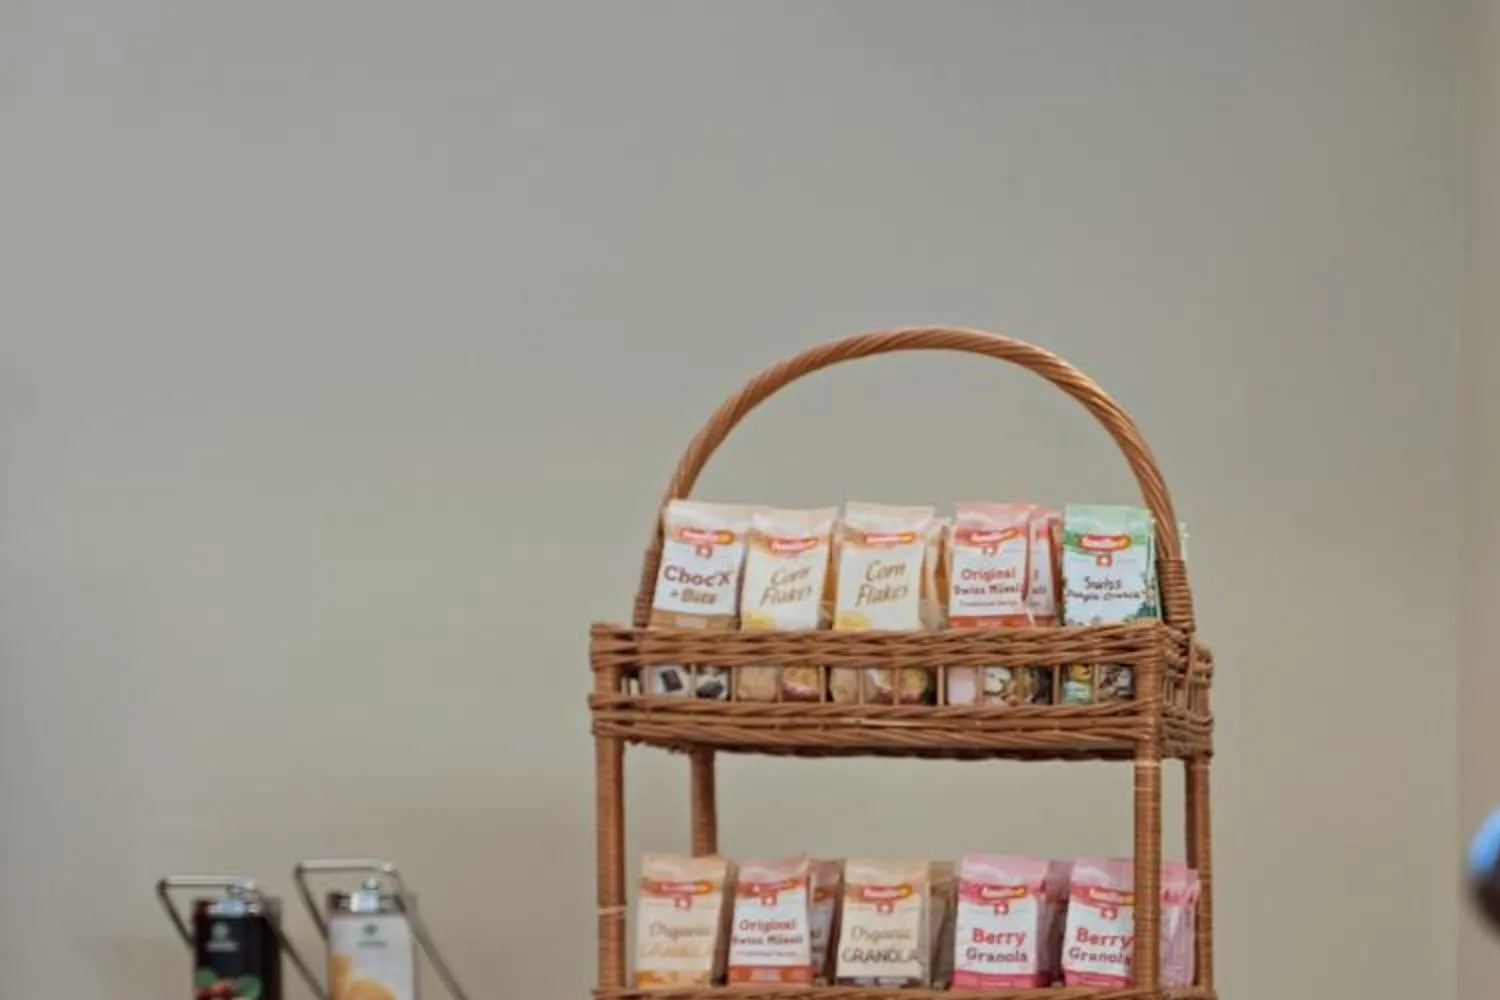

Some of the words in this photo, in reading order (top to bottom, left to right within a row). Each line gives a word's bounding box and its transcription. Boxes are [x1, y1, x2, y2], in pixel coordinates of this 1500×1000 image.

[865, 559, 907, 582] Corn
[960, 566, 1017, 582] Original
[738, 918, 797, 934] Original
[972, 926, 1027, 947] Berry
[1075, 926, 1136, 950] Berry
[841, 947, 925, 965] GRANOLA
[965, 946, 1029, 963] Granola
[1068, 946, 1132, 966] Granola
